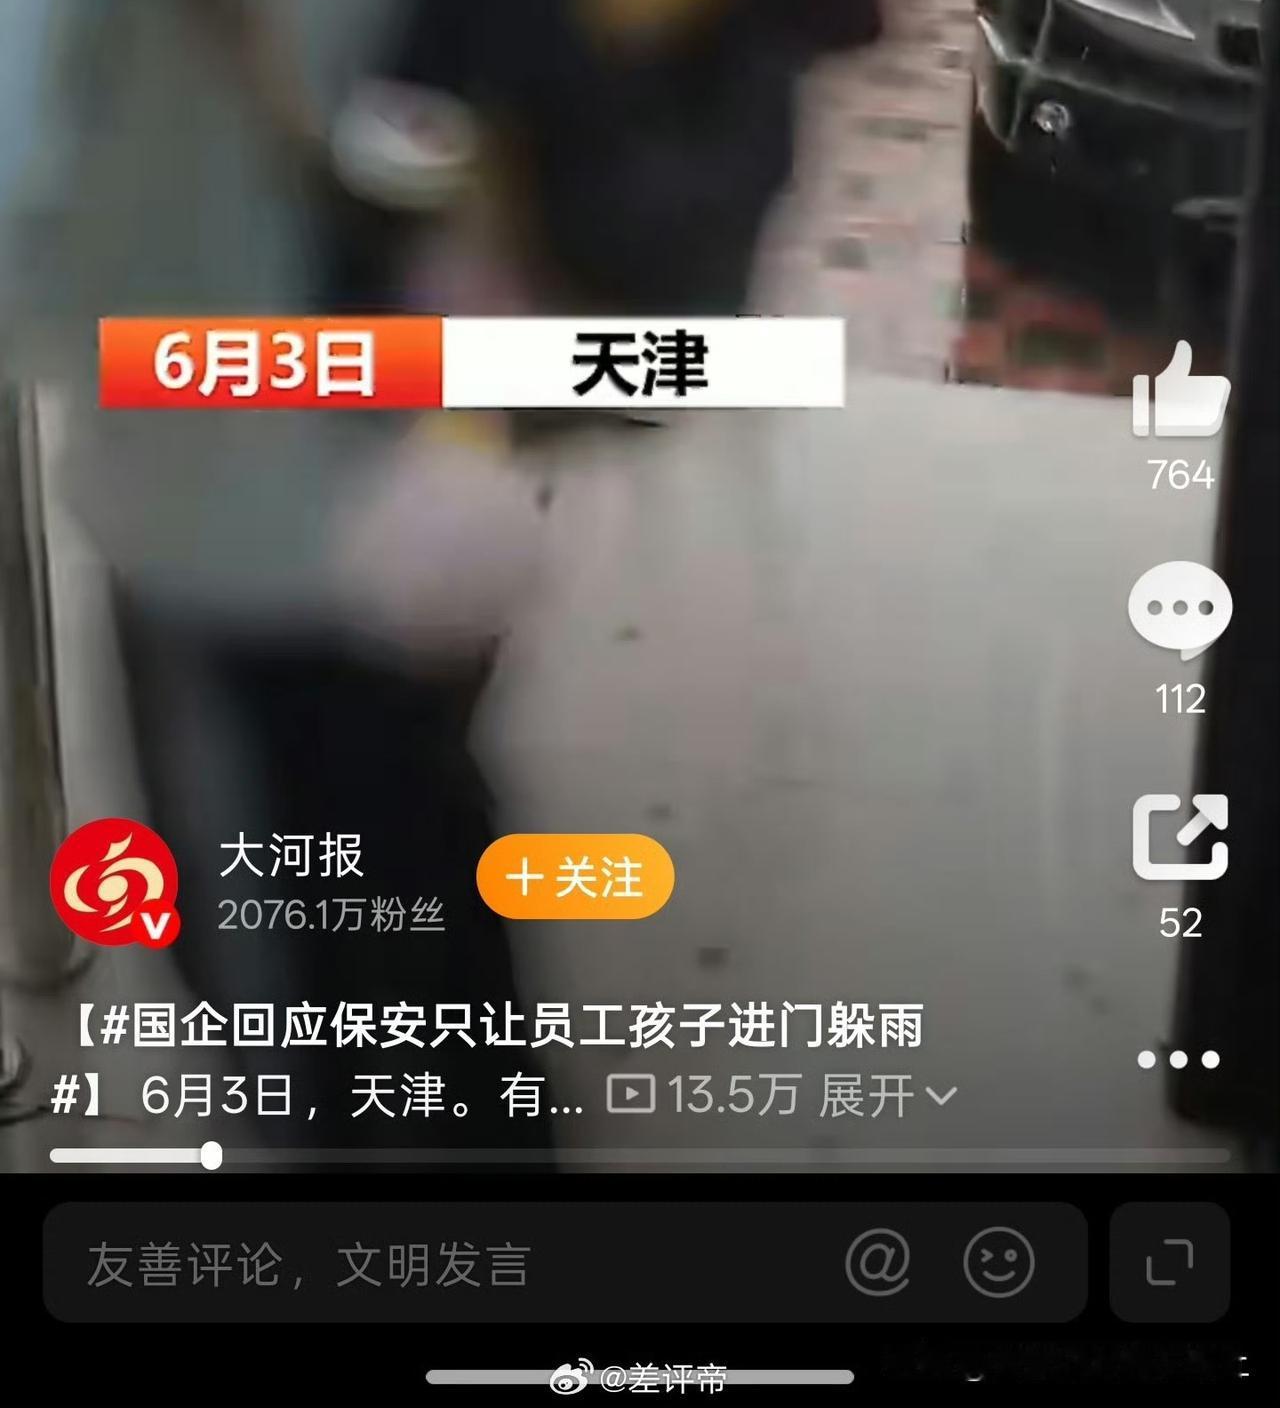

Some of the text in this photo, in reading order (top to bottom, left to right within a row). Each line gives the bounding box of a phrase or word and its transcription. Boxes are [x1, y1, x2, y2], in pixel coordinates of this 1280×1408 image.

[1146, 459, 1216, 490] 764
[1155, 683, 1206, 713] 112
[219, 831, 365, 878] 大河报
[217, 895, 446, 933] 2076.1万粉丝
[1159, 907, 1203, 938] 52
[76, 999, 925, 1050] 【#国企回应保安只让员工孩子进门躲雨
[667, 1073, 803, 1116] 13.5万
[818, 1073, 915, 1118] 展开
[86, 1240, 532, 1291] 友善评论，文明发言
